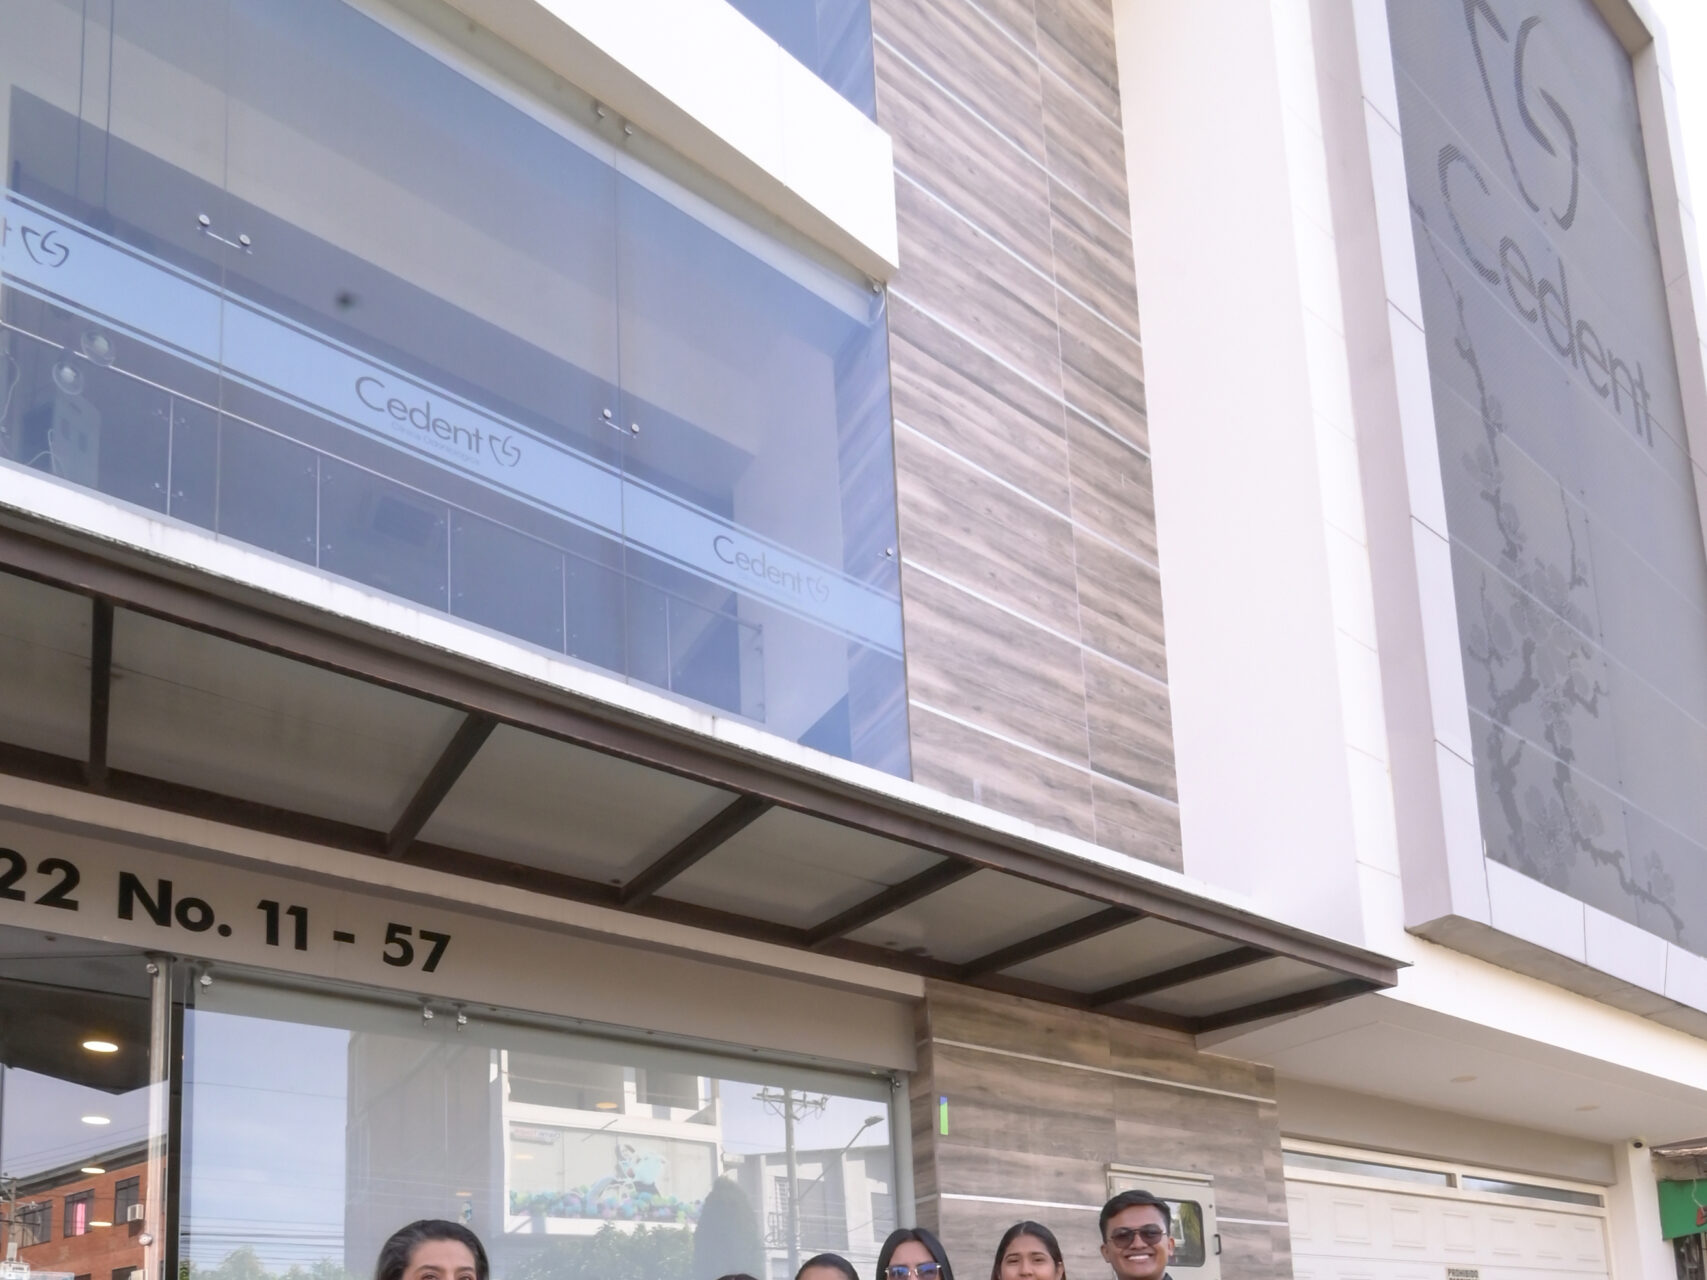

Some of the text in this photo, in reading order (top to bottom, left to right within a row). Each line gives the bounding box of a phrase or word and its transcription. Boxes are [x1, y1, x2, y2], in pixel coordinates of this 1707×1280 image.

[1437, 143, 1653, 447] Cedent
[355, 376, 483, 454] Cedent
[713, 535, 802, 594] Cedent
[117, 871, 232, 938] No.
[257, 899, 308, 951] 11
[333, 930, 355, 944] -
[382, 922, 451, 973] 57
